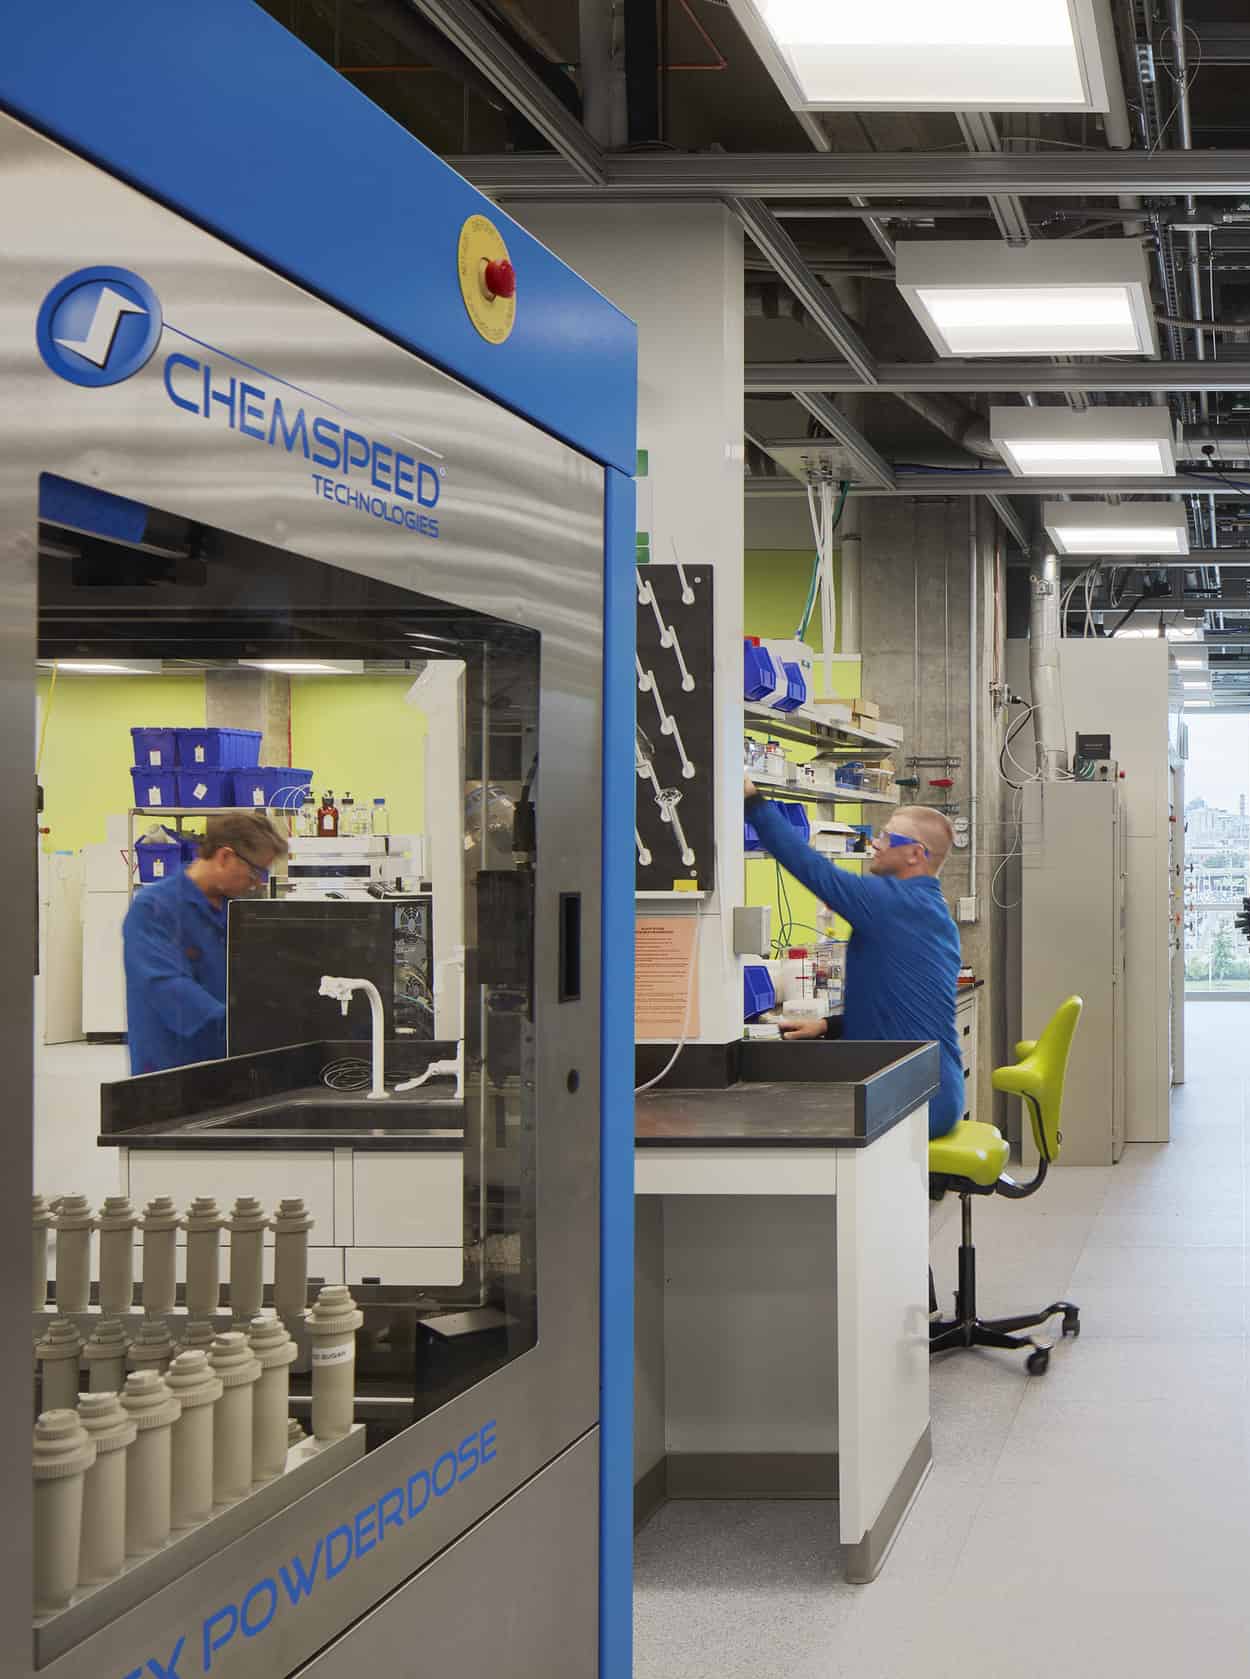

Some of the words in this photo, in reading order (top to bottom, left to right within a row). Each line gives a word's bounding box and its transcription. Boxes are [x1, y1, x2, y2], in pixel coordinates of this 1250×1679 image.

[164, 352, 440, 509] CHEMSPEED
[312, 473, 439, 539] TECHNOLOGIES
[203, 1419, 497, 1672] POWDERDOSE
